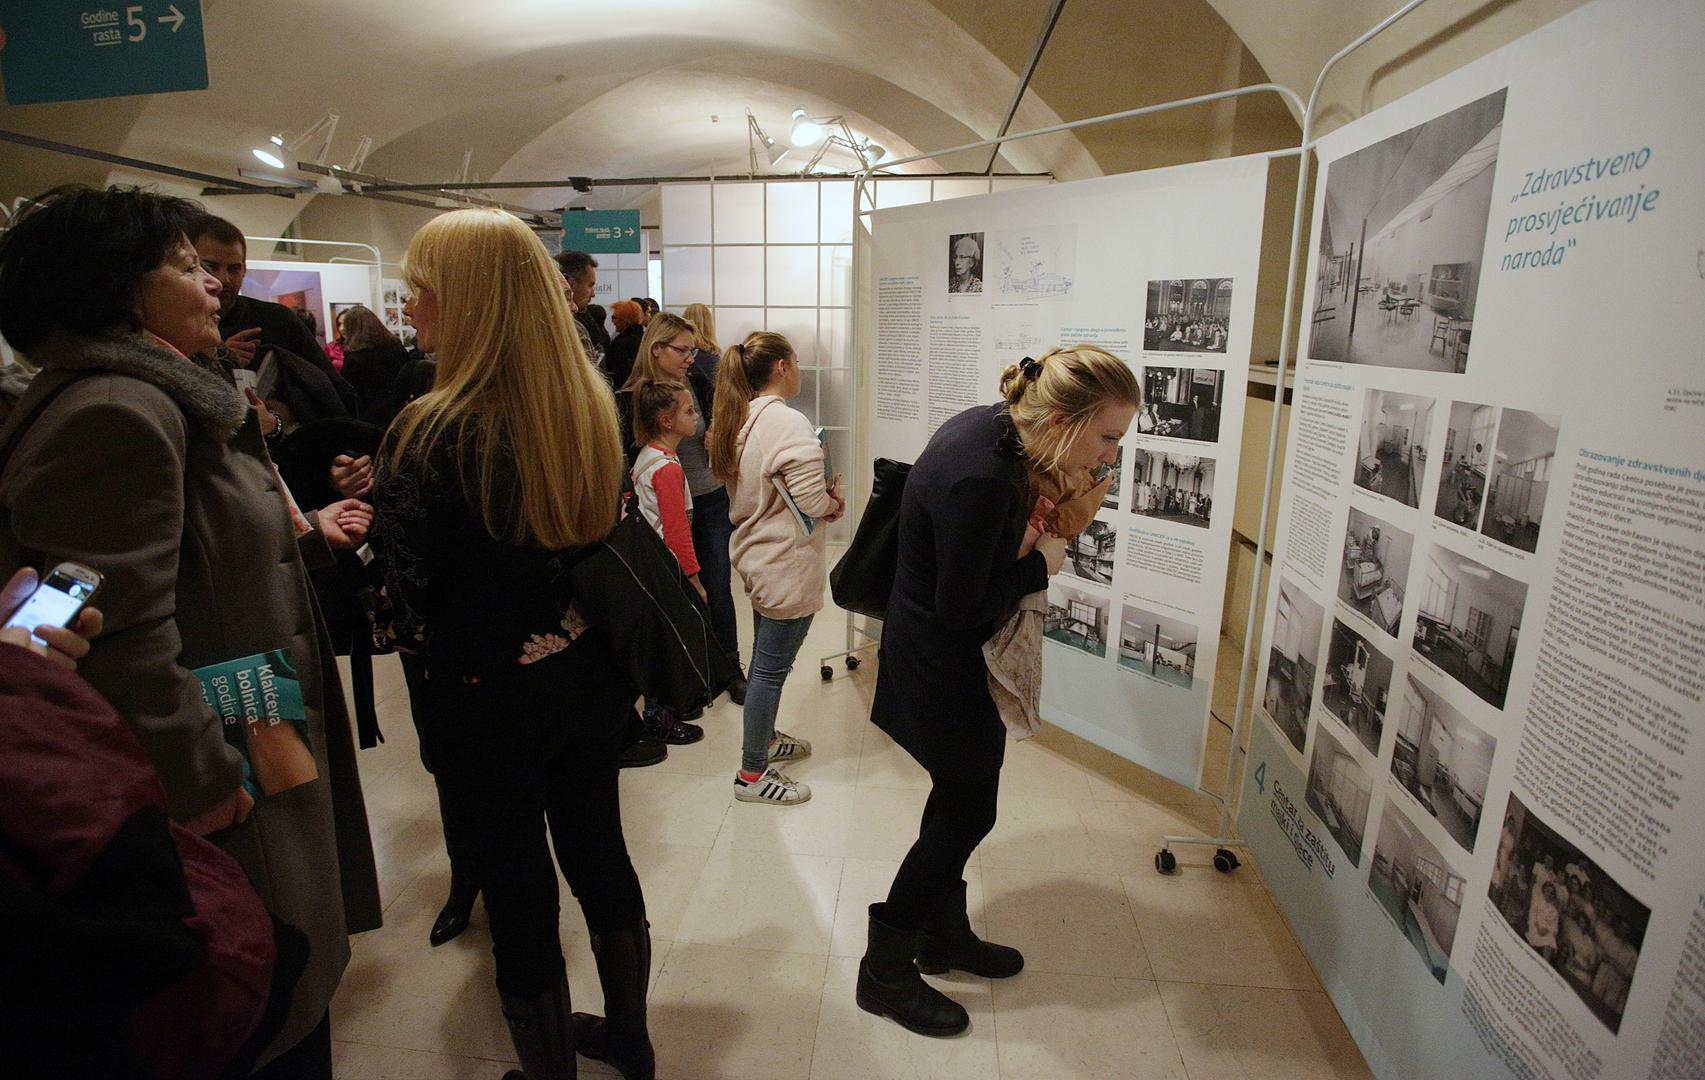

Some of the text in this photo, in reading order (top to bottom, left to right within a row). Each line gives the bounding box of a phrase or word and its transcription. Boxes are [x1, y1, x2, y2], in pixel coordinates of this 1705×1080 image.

[81, 10, 119, 25] Godine
[93, 28, 121, 42] rasta
[126, 6, 147, 43] 5
[1504, 184, 1660, 243] prosvjećivanje
[613, 226, 622, 239] 3
[1578, 447, 1626, 467] Obrazovanje
[1627, 457, 1691, 480] zdravstvenih
[211, 675, 238, 725] godine
[236, 669, 259, 725] bolnica
[258, 664, 281, 726] Klaićeva
[1255, 761, 1266, 795] 4
